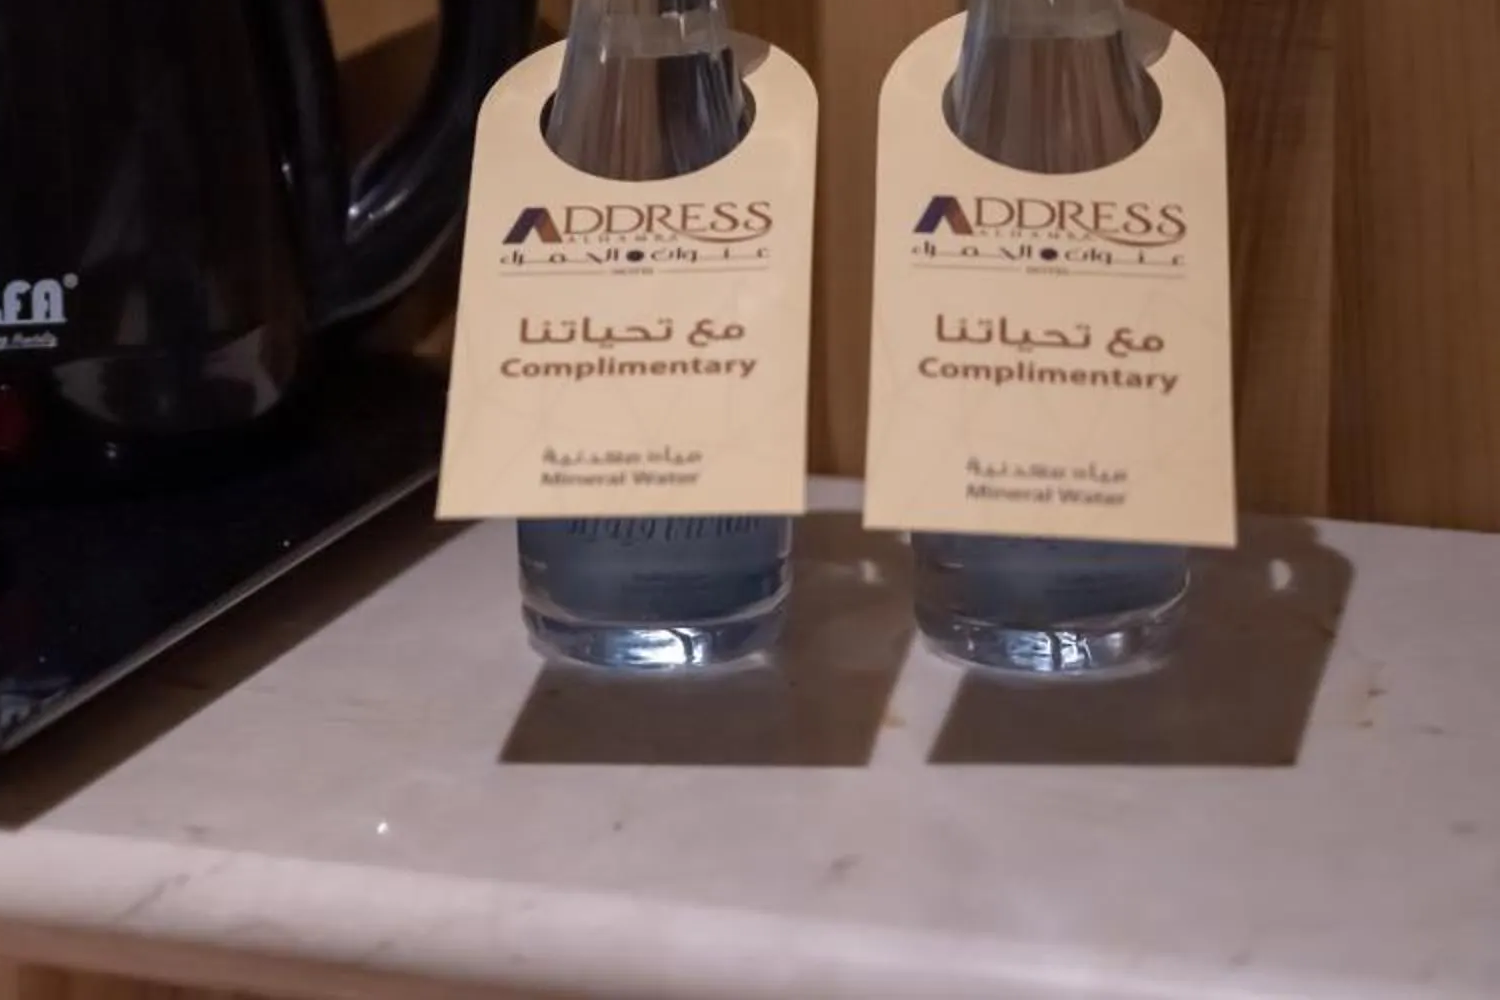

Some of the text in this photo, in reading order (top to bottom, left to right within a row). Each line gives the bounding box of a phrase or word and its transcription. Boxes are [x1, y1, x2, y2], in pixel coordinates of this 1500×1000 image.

[502, 201, 774, 246] ADDRESS
[913, 194, 1187, 248] ADDRESS
[518, 316, 746, 348] مع تحياتنا
[936, 313, 1165, 358] مع تحياتنا
[500, 355, 757, 381] Complimentary
[918, 356, 1179, 395] Complimentary
[540, 470, 698, 486] Mineral Water
[965, 483, 1126, 505] Mineral Water
